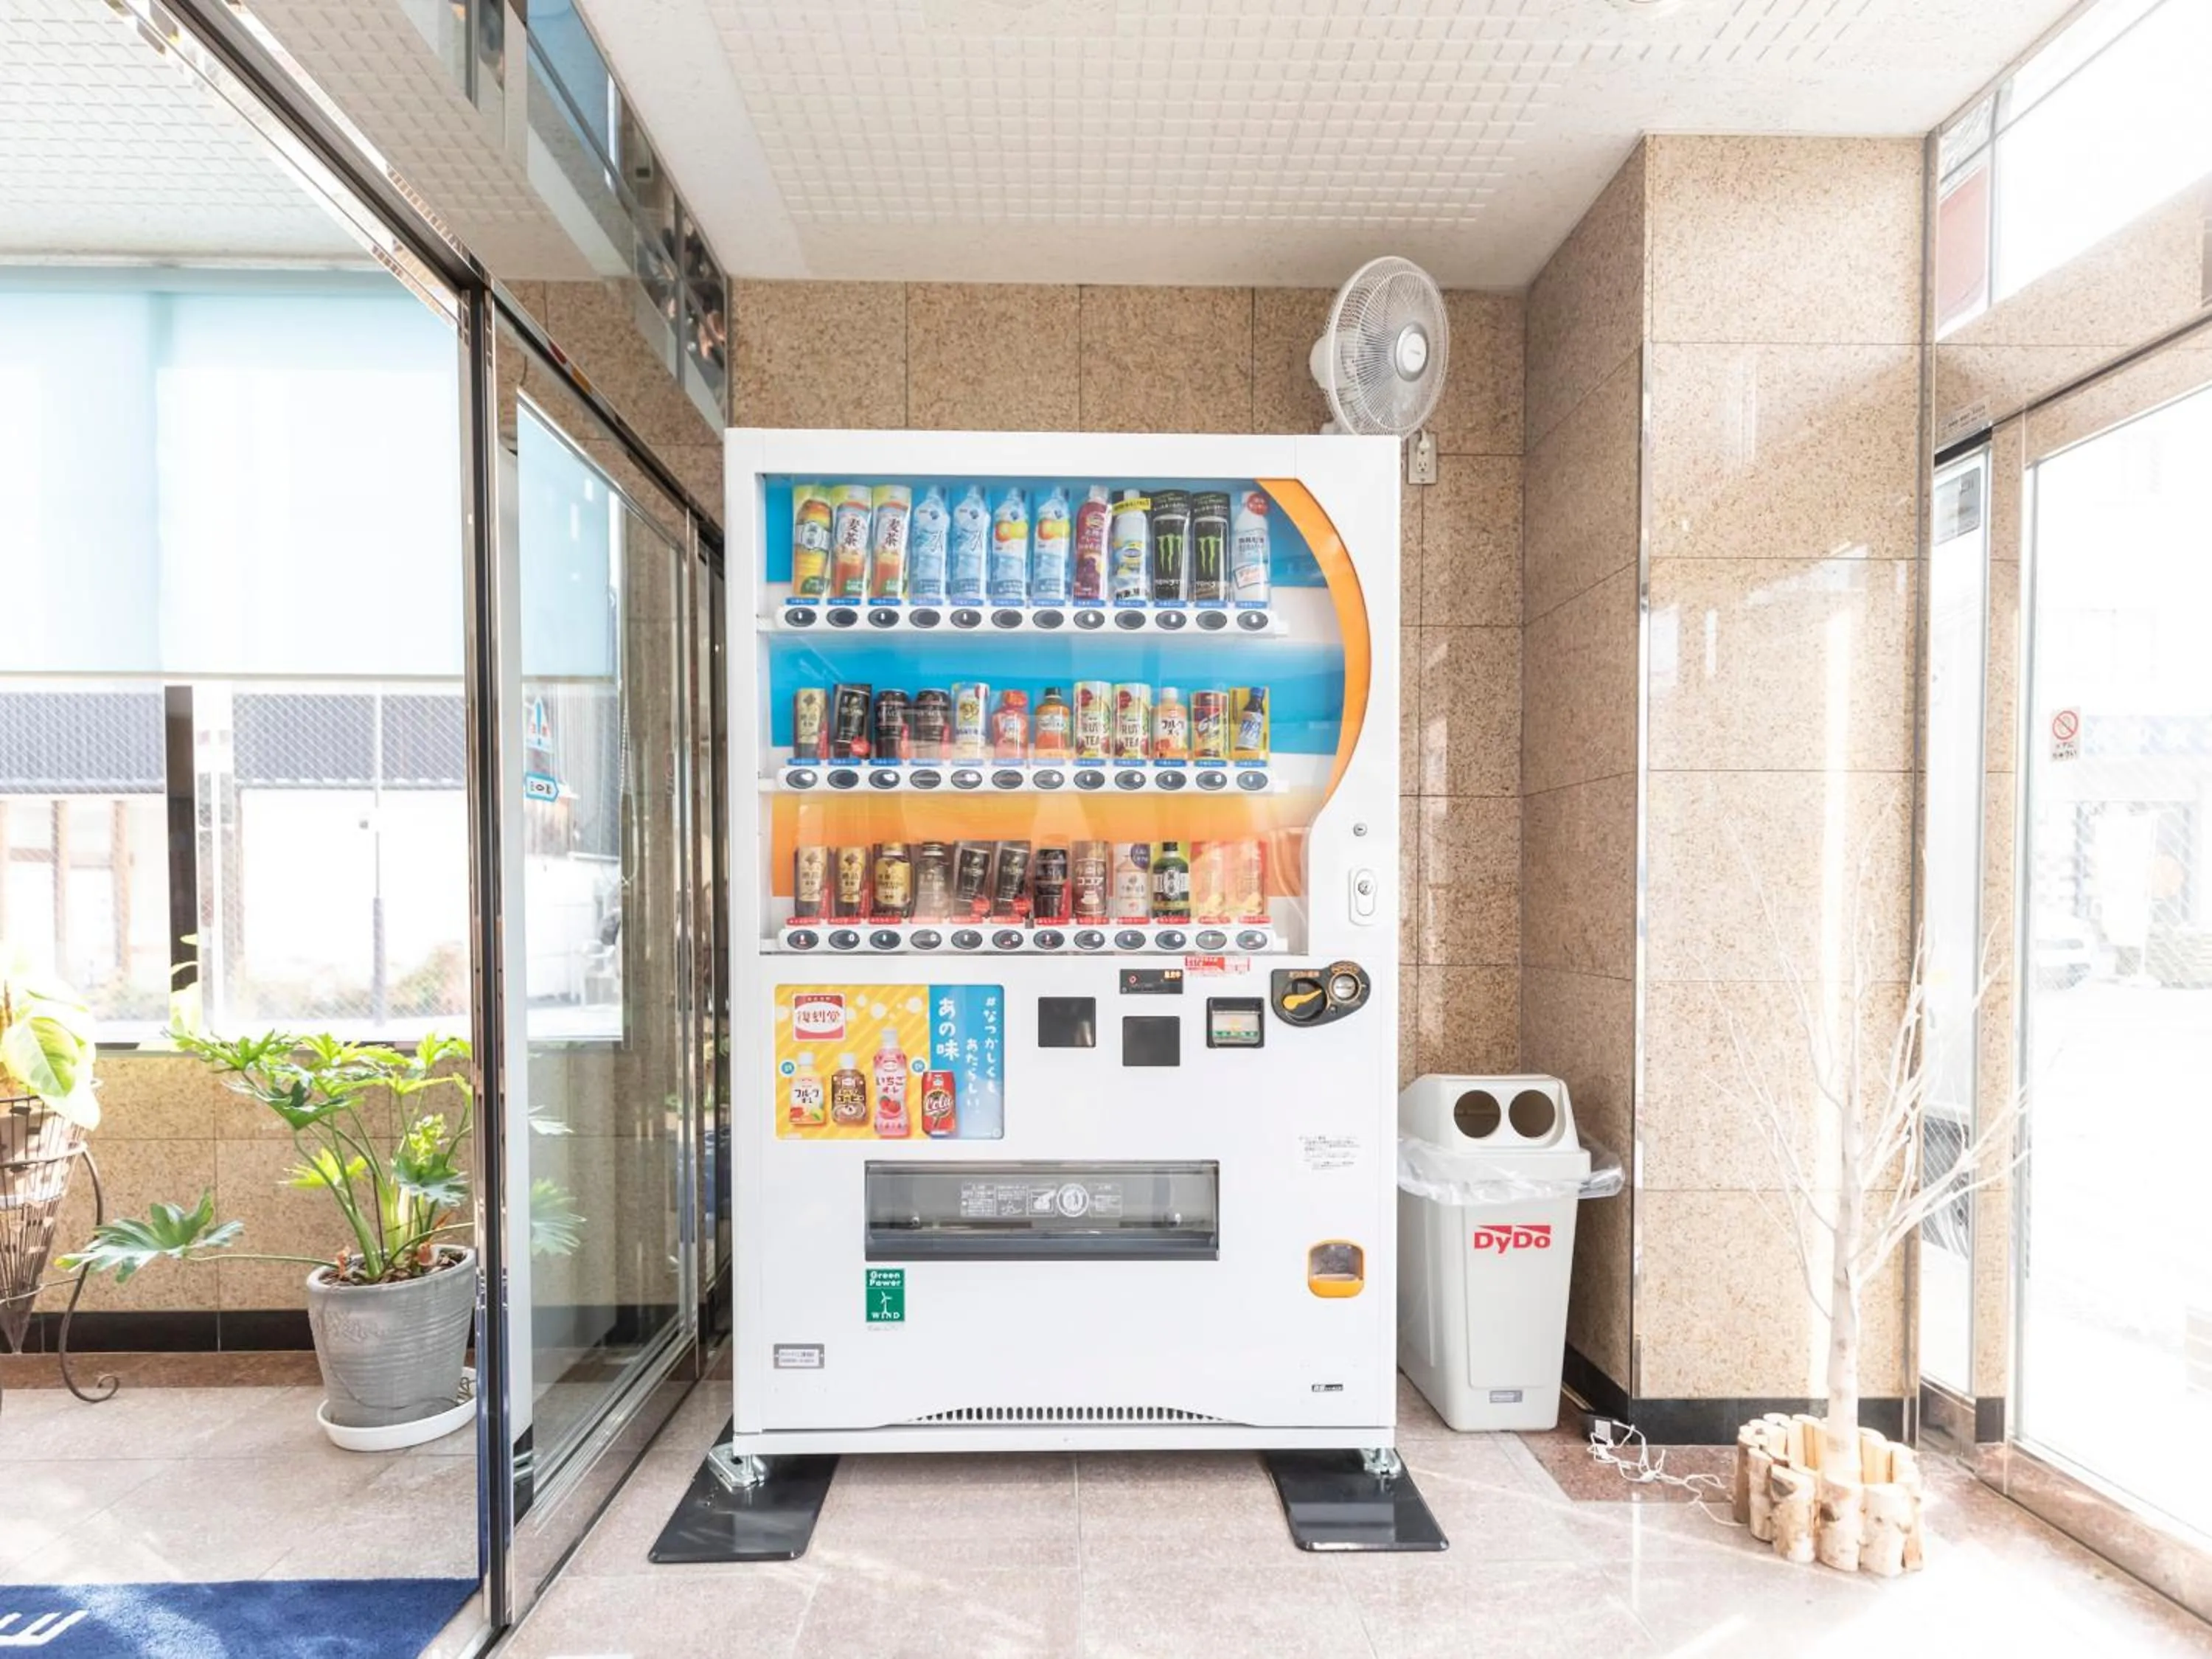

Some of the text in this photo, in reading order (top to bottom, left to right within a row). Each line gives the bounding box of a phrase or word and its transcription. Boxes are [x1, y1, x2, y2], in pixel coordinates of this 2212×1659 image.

[845, 518, 860, 546] 麦茶
[886, 518, 900, 546] 麦茶
[936, 997, 960, 1061] あの味
[1475, 1225, 1550, 1253] DyDo
[870, 1270, 900, 1279] Green
